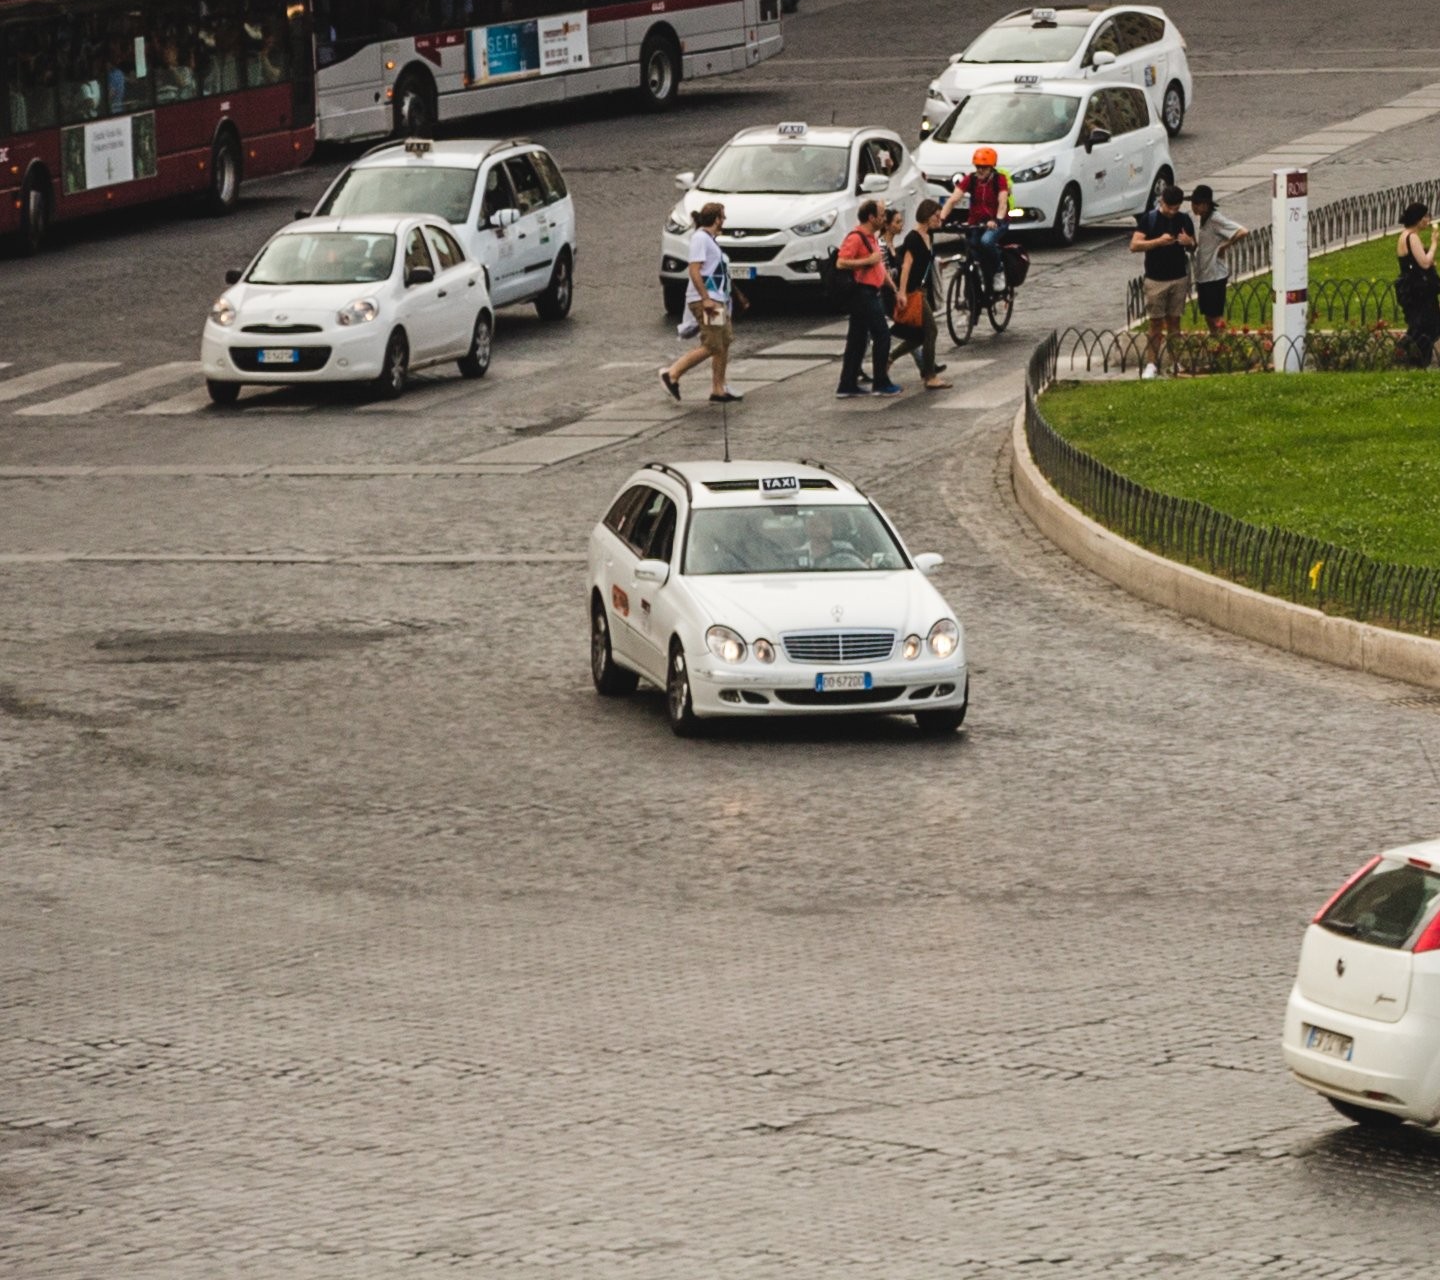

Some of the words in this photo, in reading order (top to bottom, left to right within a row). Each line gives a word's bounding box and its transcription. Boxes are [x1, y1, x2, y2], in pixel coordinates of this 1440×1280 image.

[488, 32, 518, 53] SETA
[778, 125, 804, 135] TAXI
[763, 477, 797, 490] TAXI
